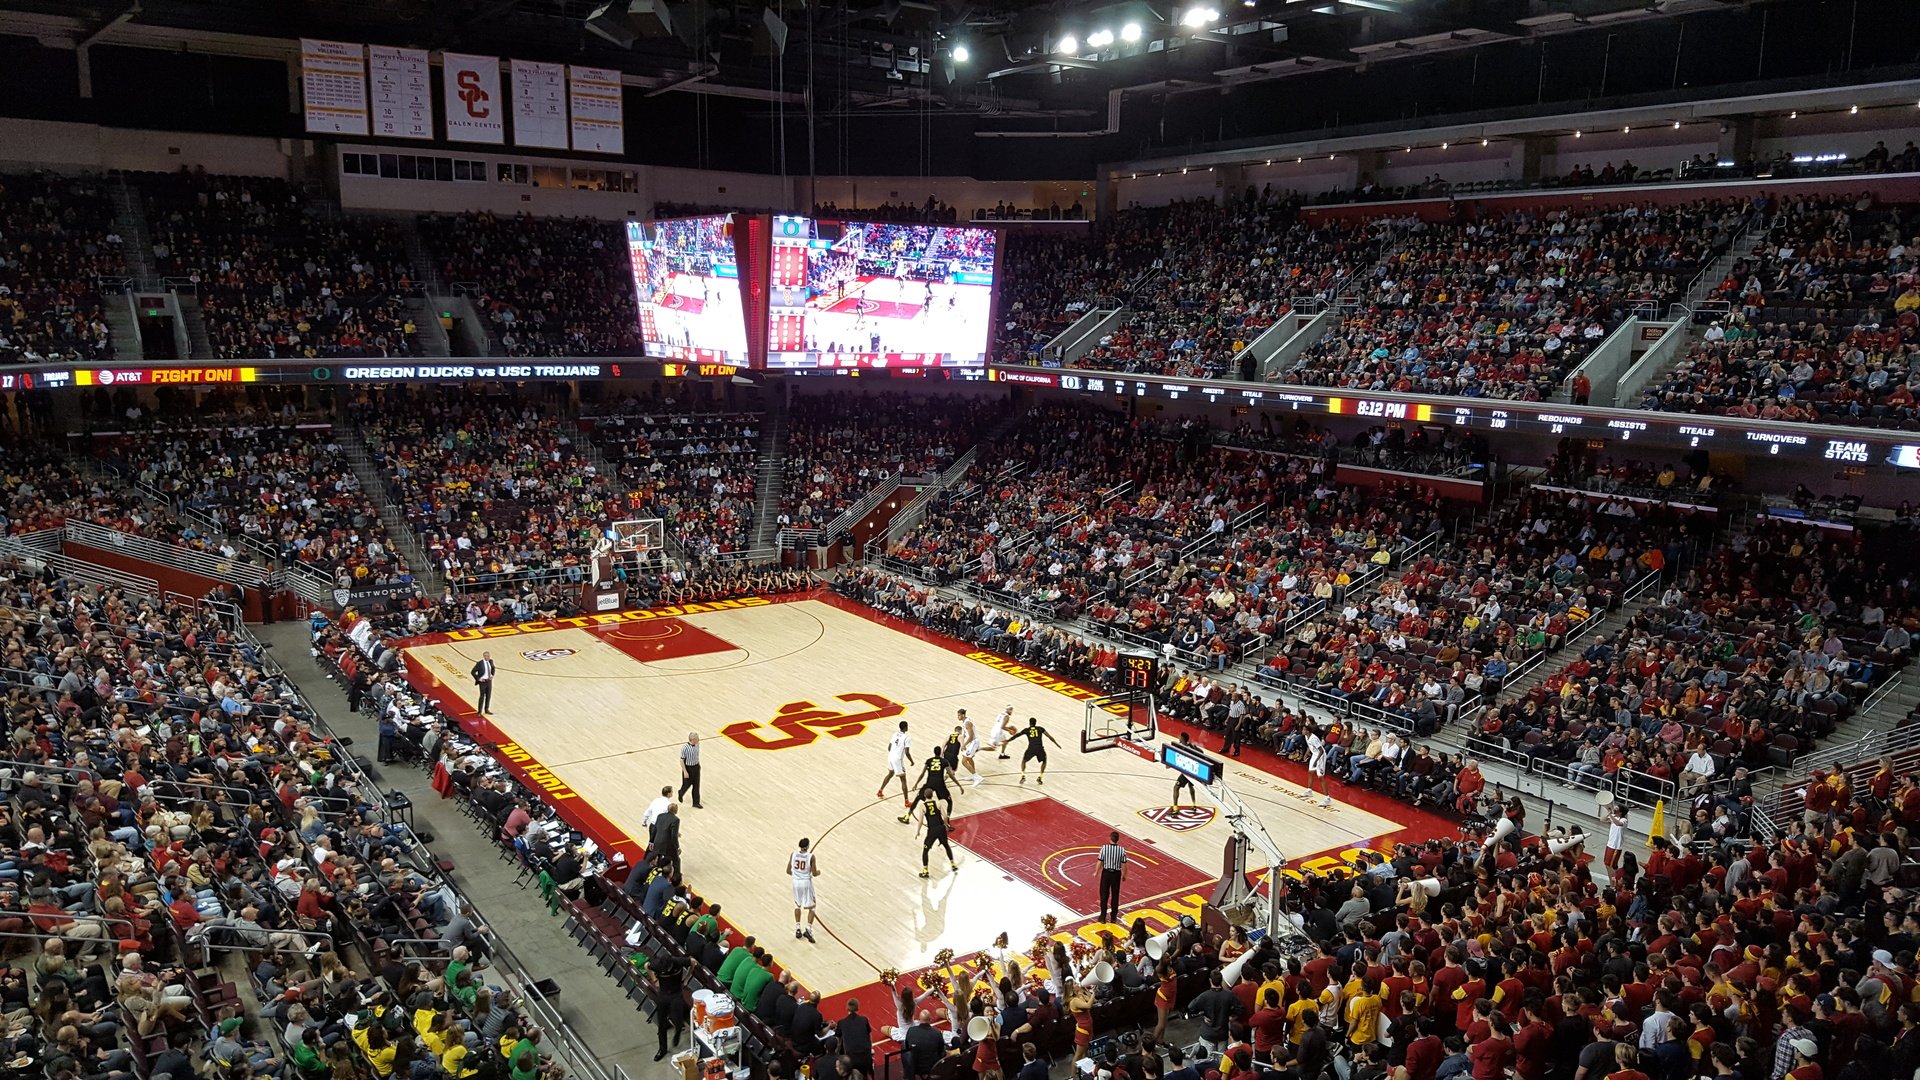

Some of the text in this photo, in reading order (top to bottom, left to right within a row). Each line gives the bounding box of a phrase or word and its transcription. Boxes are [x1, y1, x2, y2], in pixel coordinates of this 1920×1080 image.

[345, 366, 600, 378] OREGON DUCKS vs USC TROJANS
[718, 365, 736, 375] ON!
[43, 372, 69, 381] TROJANS
[116, 372, 142, 382] AT&T
[152, 369, 232, 383] FIGHT ON!
[1026, 376, 1051, 384] CALIFORNIA
[2, 376, 14, 388] 17
[1162, 384, 1189, 392] REBOUNDS
[1202, 387, 1224, 395] ASSISTS
[1280, 394, 1313, 402] TURNOVERS
[1357, 401, 1406, 419] 8:12 PM
[1455, 407, 1470, 415] FG%
[1492, 410, 1508, 418] FT%
[1456, 416, 1466, 425] 21
[1490, 419, 1505, 429] 100
[1538, 414, 1582, 424] REBOUNDS
[1551, 424, 1562, 434] 14
[1608, 420, 1646, 430] ASSISTS
[1622, 430, 1630, 440] 3
[1679, 426, 1714, 436] STEALS
[1691, 437, 1699, 447] 2
[1746, 432, 1806, 444] TURNOVERS
[1828, 441, 1867, 453] TEAM
[1825, 450, 1868, 462] STATS
[445, 596, 771, 641] USC TROJANS
[965, 651, 1055, 684] CENTER
[1128, 658, 1151, 670] 4:27
[1129, 671, 1147, 688] 17
[1030, 729, 1038, 737] 31
[1330, 726, 1340, 735] SC
[931, 762, 941, 771] 25
[930, 805, 935, 816] 2
[794, 860, 806, 870] 30
